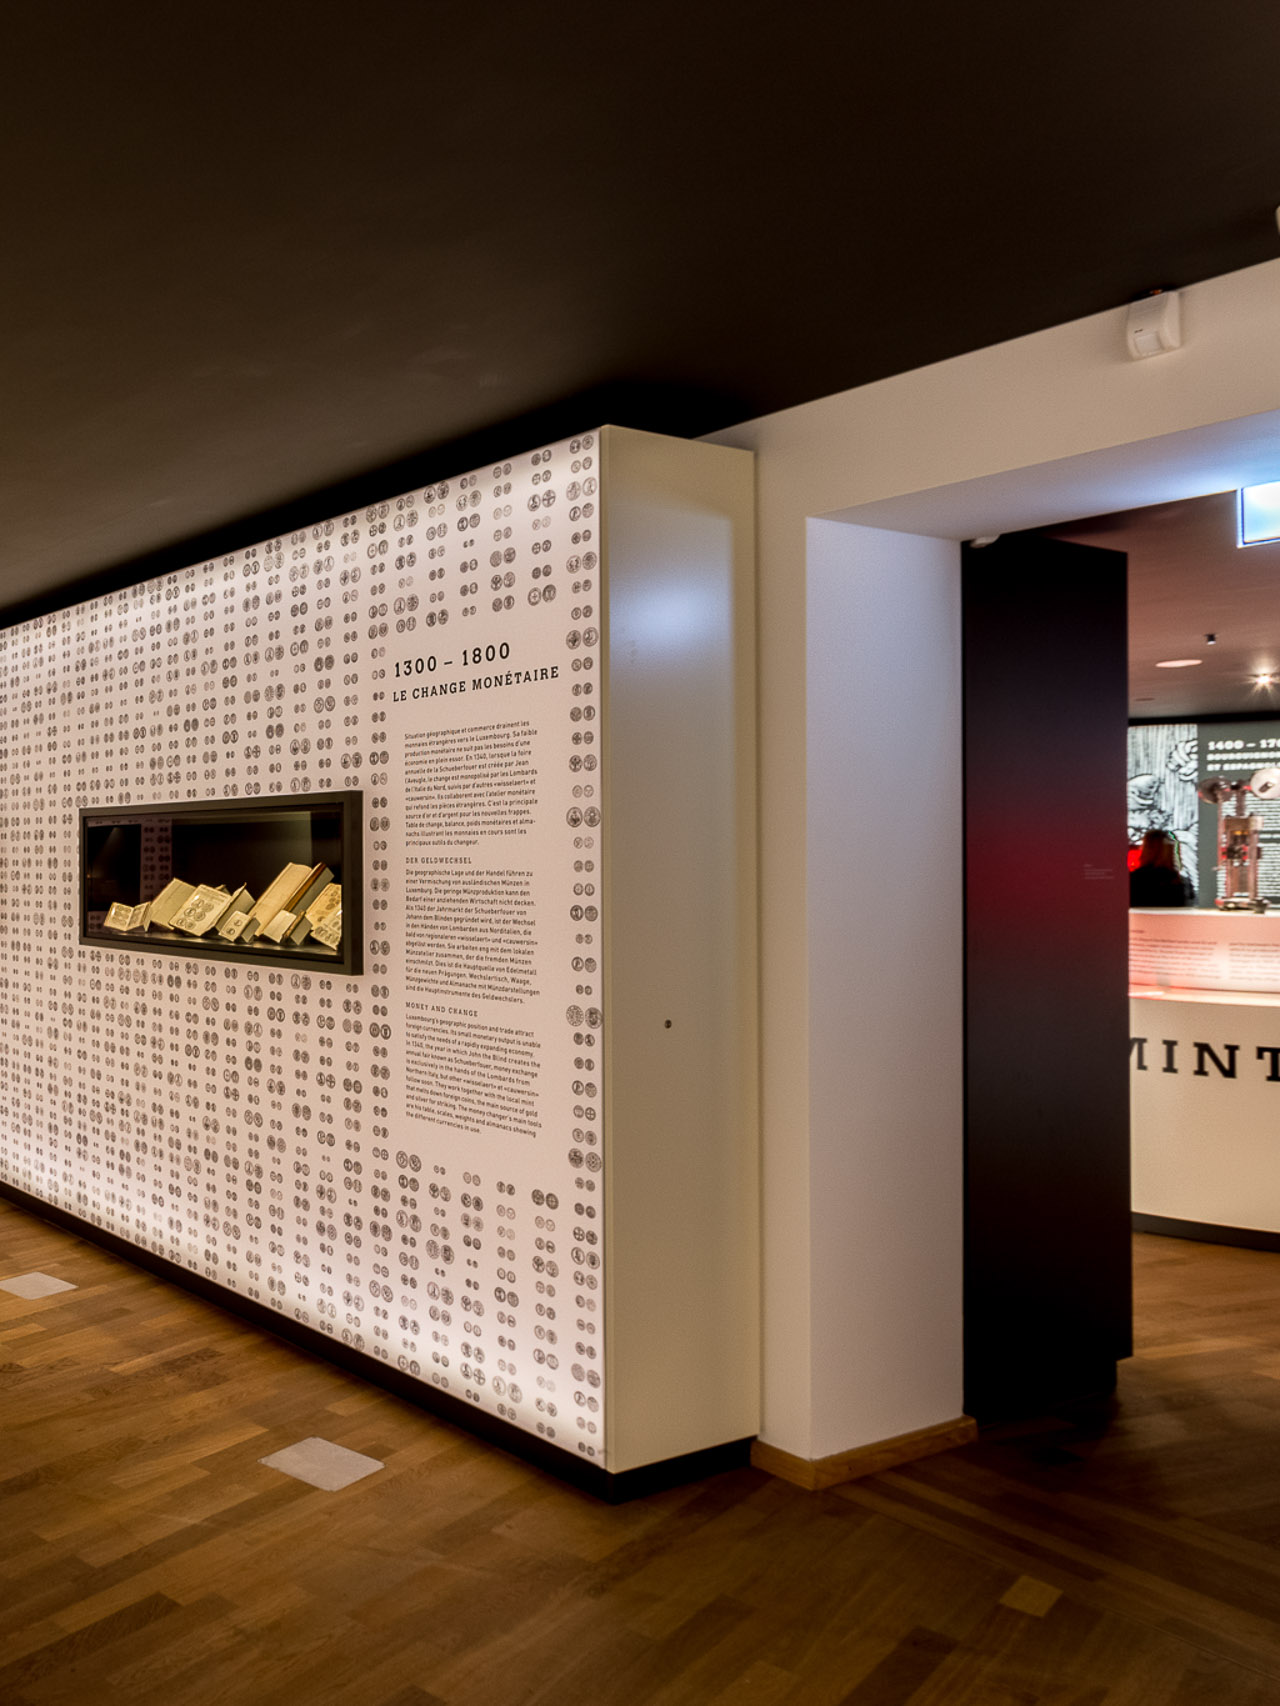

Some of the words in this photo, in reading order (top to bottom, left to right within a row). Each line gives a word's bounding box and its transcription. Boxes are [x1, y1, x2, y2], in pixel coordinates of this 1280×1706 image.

[395, 655, 437, 678] 1300
[462, 642, 510, 667] 1800
[393, 690, 407, 703] LE
[412, 681, 467, 700] CHANGE
[472, 666, 560, 691] MONÉTAIRE
[406, 1001, 429, 1011] MONEY
[431, 1004, 446, 1013] AND
[448, 1007, 478, 1018] CHANGE
